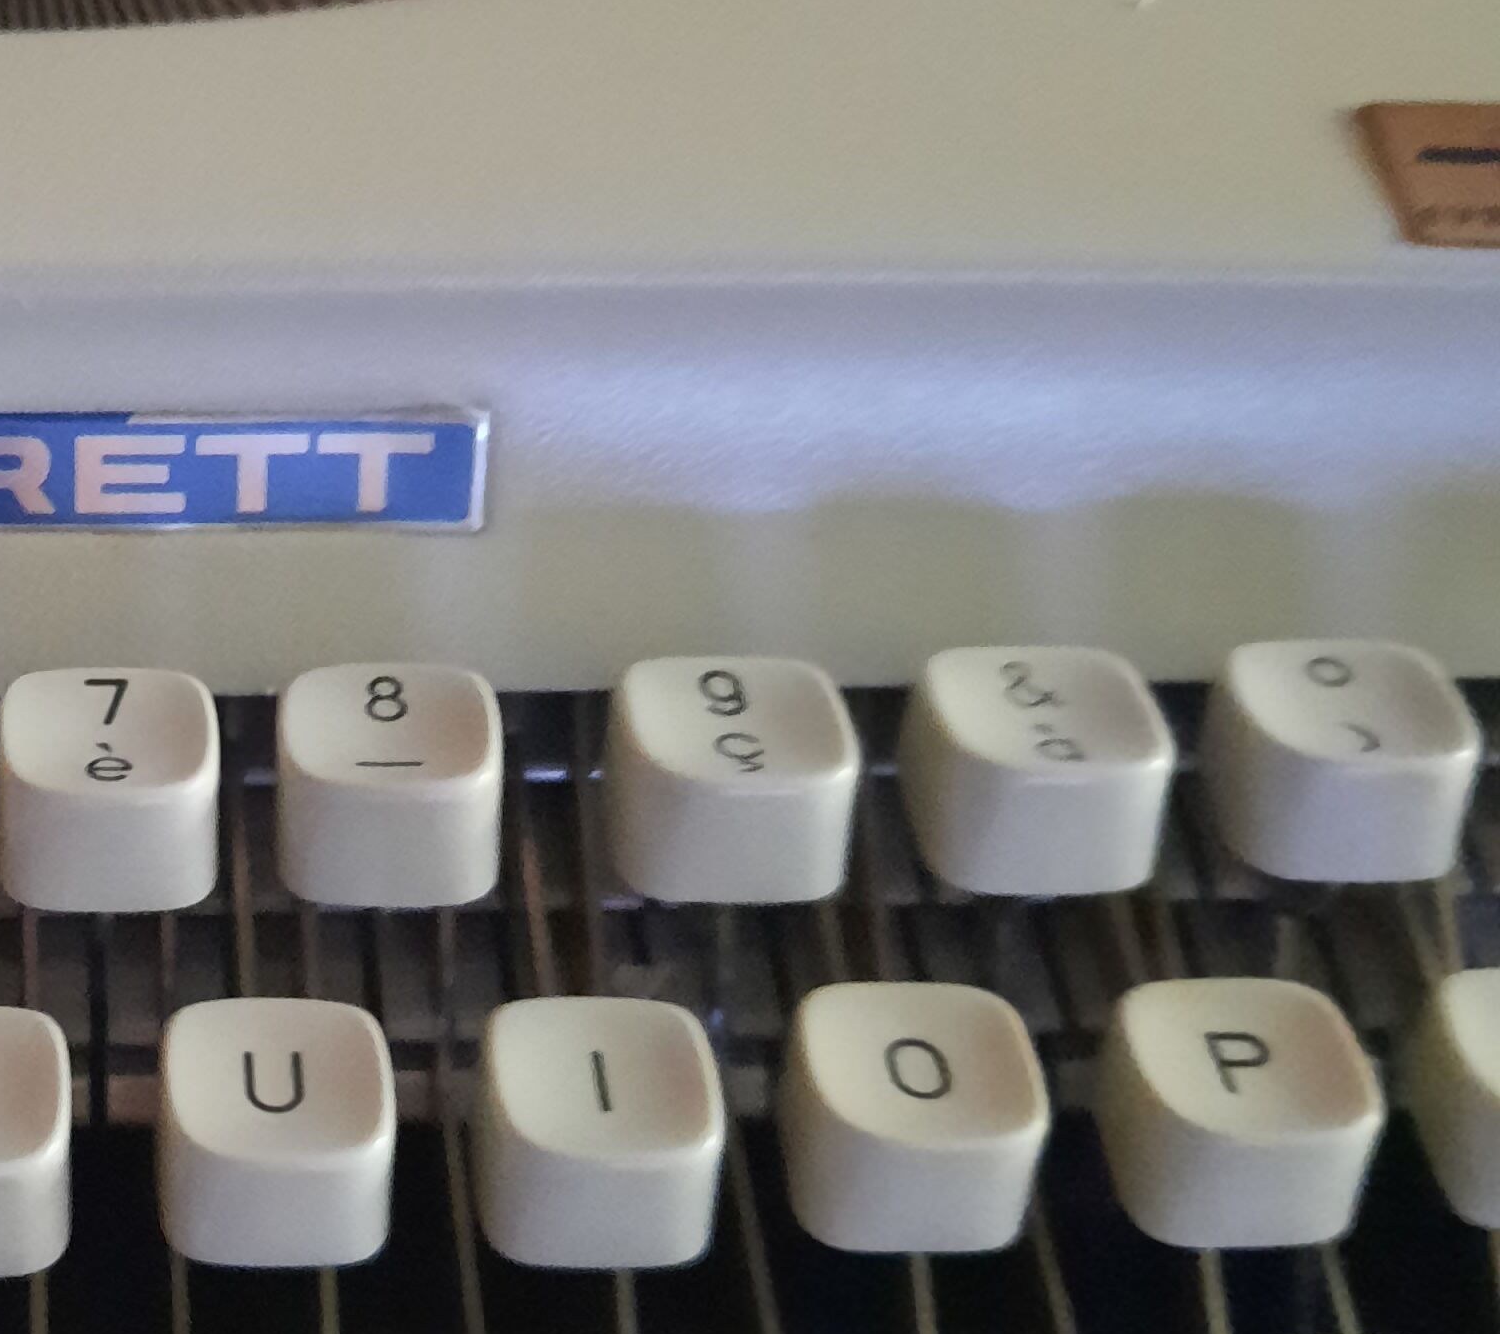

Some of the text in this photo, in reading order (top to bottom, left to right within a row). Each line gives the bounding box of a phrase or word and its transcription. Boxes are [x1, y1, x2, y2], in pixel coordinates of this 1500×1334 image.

[83, 678, 129, 725] 7
[364, 676, 409, 721] 8
[699, 670, 748, 716] 9
[84, 742, 134, 782] è
[243, 1051, 304, 1113] U
[590, 1050, 611, 1113] I
[884, 1037, 953, 1099] O
[1204, 1031, 1270, 1094] P
